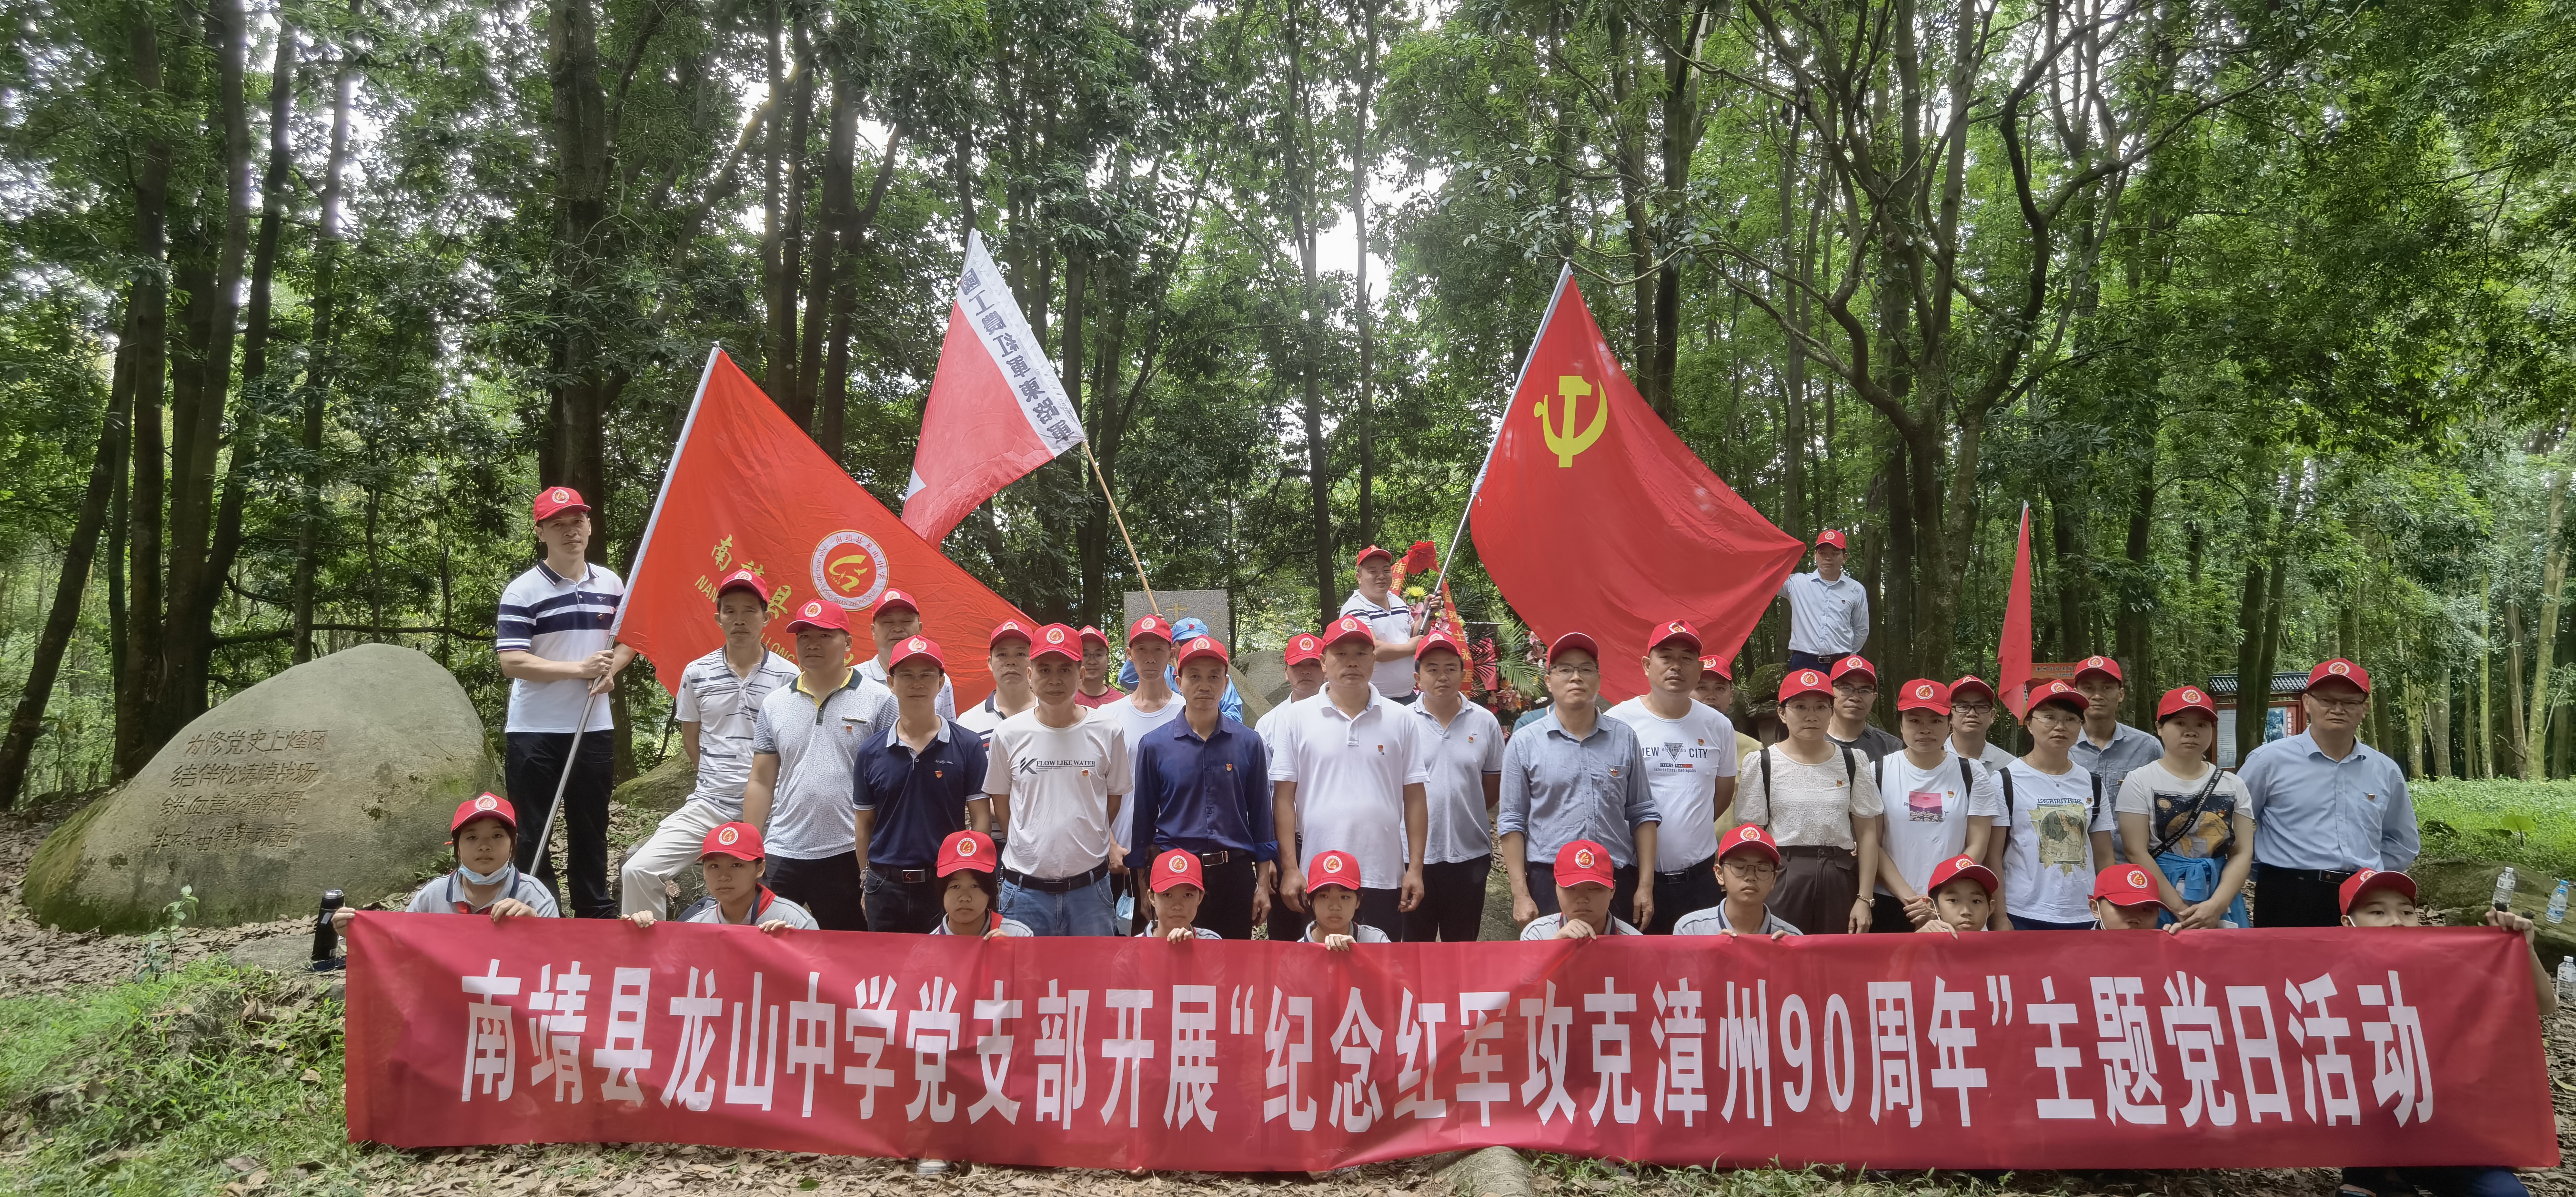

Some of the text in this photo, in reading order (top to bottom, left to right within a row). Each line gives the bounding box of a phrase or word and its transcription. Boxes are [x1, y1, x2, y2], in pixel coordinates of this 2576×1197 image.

[834, 598, 848, 606] SHAN
[1642, 747, 1659, 757] EW
[1689, 748, 1708, 759] CITY
